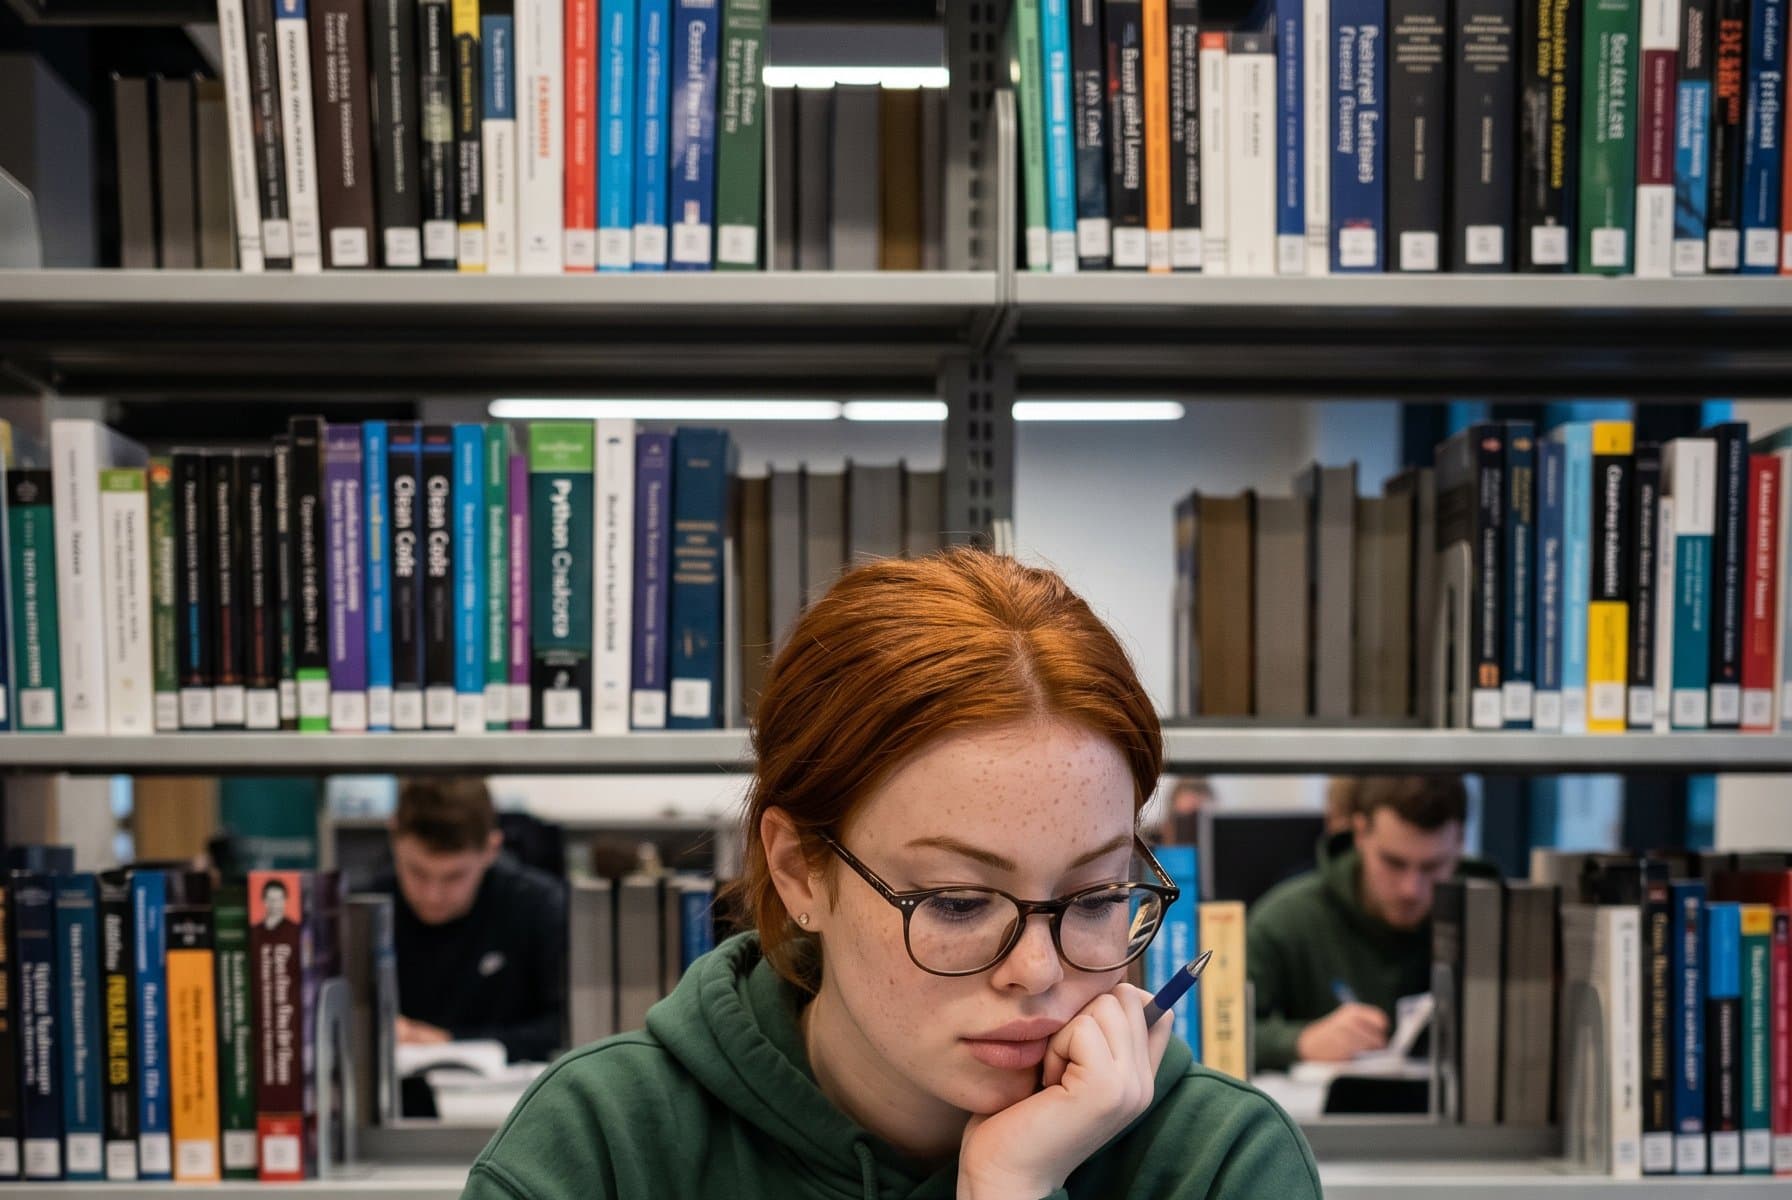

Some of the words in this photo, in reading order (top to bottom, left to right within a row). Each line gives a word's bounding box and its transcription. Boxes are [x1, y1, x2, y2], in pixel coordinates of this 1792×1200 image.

[394, 474, 416, 530] Clean
[427, 474, 449, 530] Clean
[550, 479, 573, 549] Python
[395, 530, 417, 578] Code
[428, 530, 450, 578] Code
